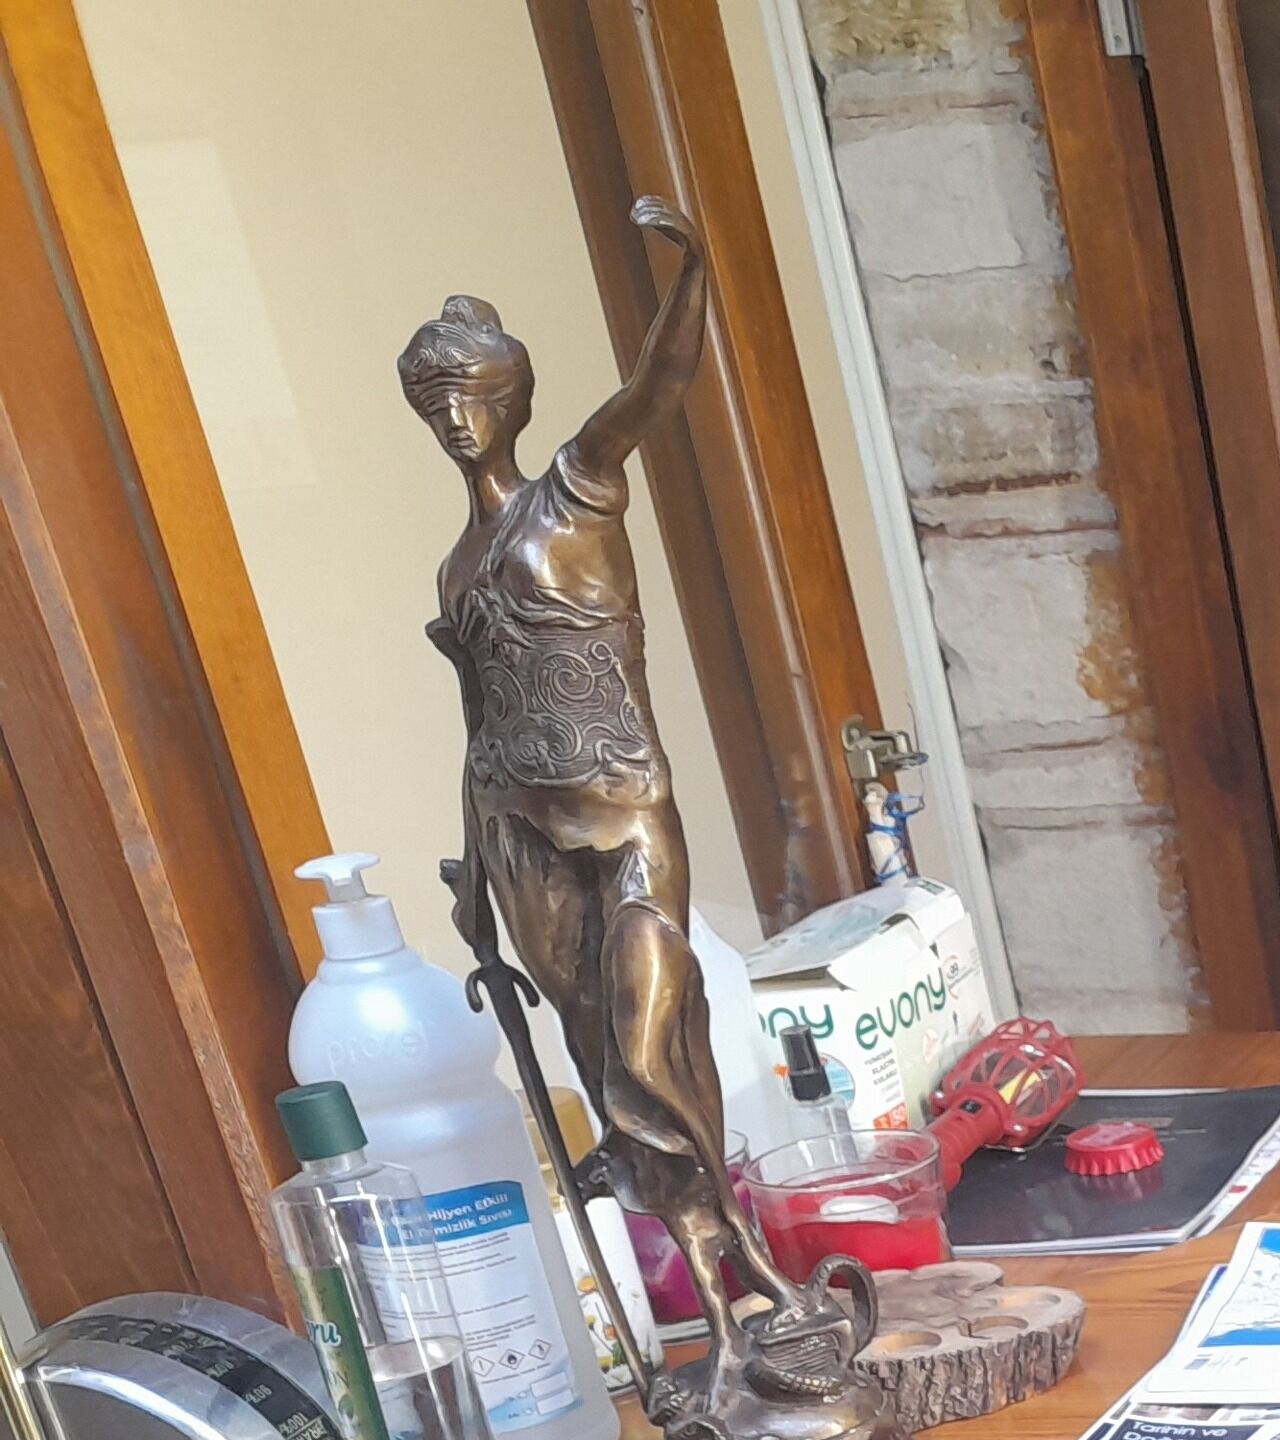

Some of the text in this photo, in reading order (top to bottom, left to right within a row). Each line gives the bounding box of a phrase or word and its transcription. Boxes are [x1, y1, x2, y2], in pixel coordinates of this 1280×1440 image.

[855, 966, 947, 1050] evony
[758, 1004, 835, 1039] ny
[428, 1206, 473, 1222] Hijyen
[1131, 1420, 1228, 1437] Tarihin ve
